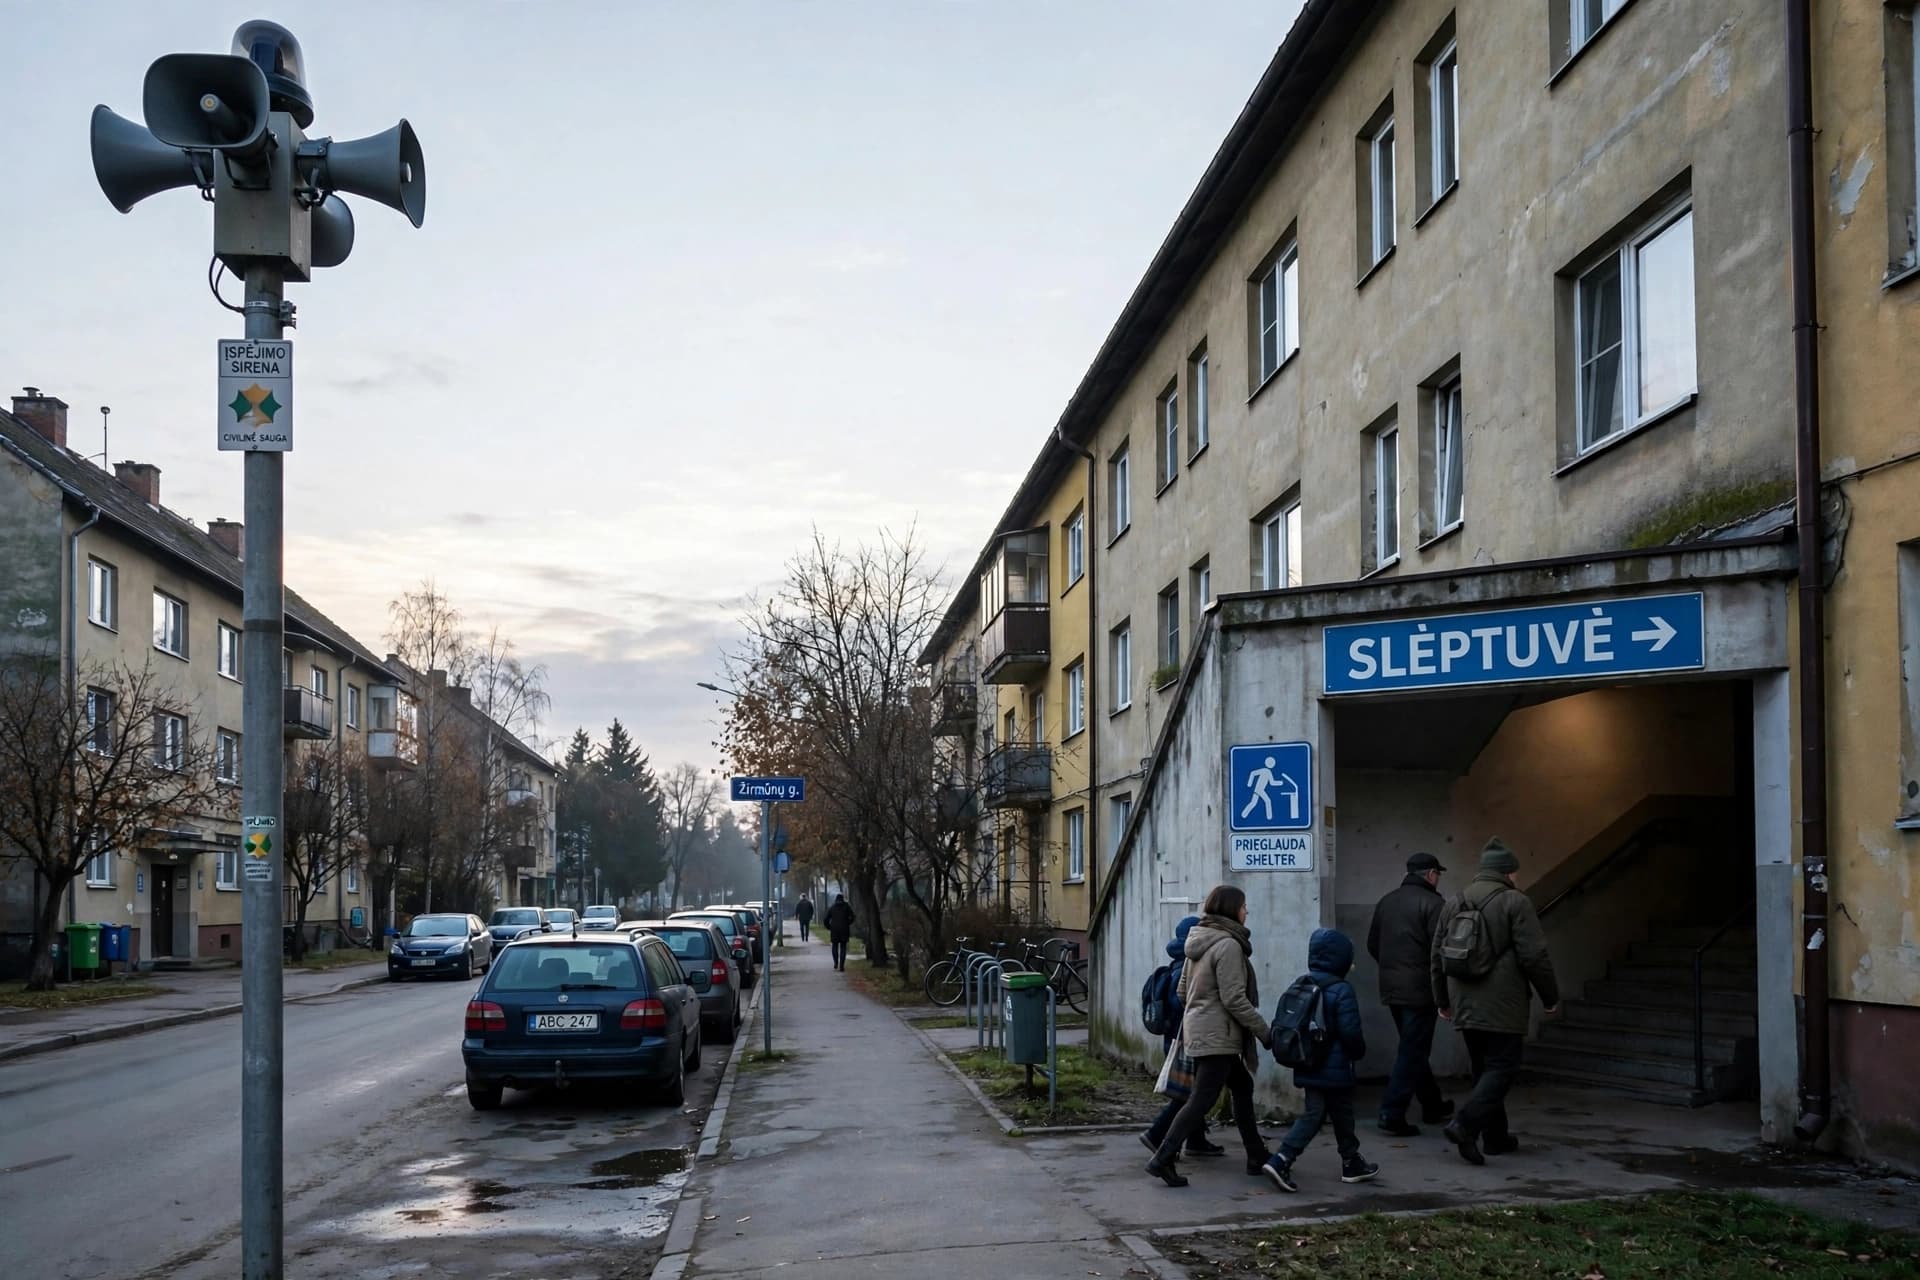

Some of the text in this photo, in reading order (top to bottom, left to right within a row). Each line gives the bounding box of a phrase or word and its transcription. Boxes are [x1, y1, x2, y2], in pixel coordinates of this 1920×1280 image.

[231, 361, 280, 374] SIRENA
[259, 434, 287, 442] SAUGA
[788, 785, 800, 798] g.
[1235, 838, 1306, 851] PRIEGLAUDA
[1246, 854, 1296, 866] SHELTER
[538, 1015, 593, 1028] ABC 247
